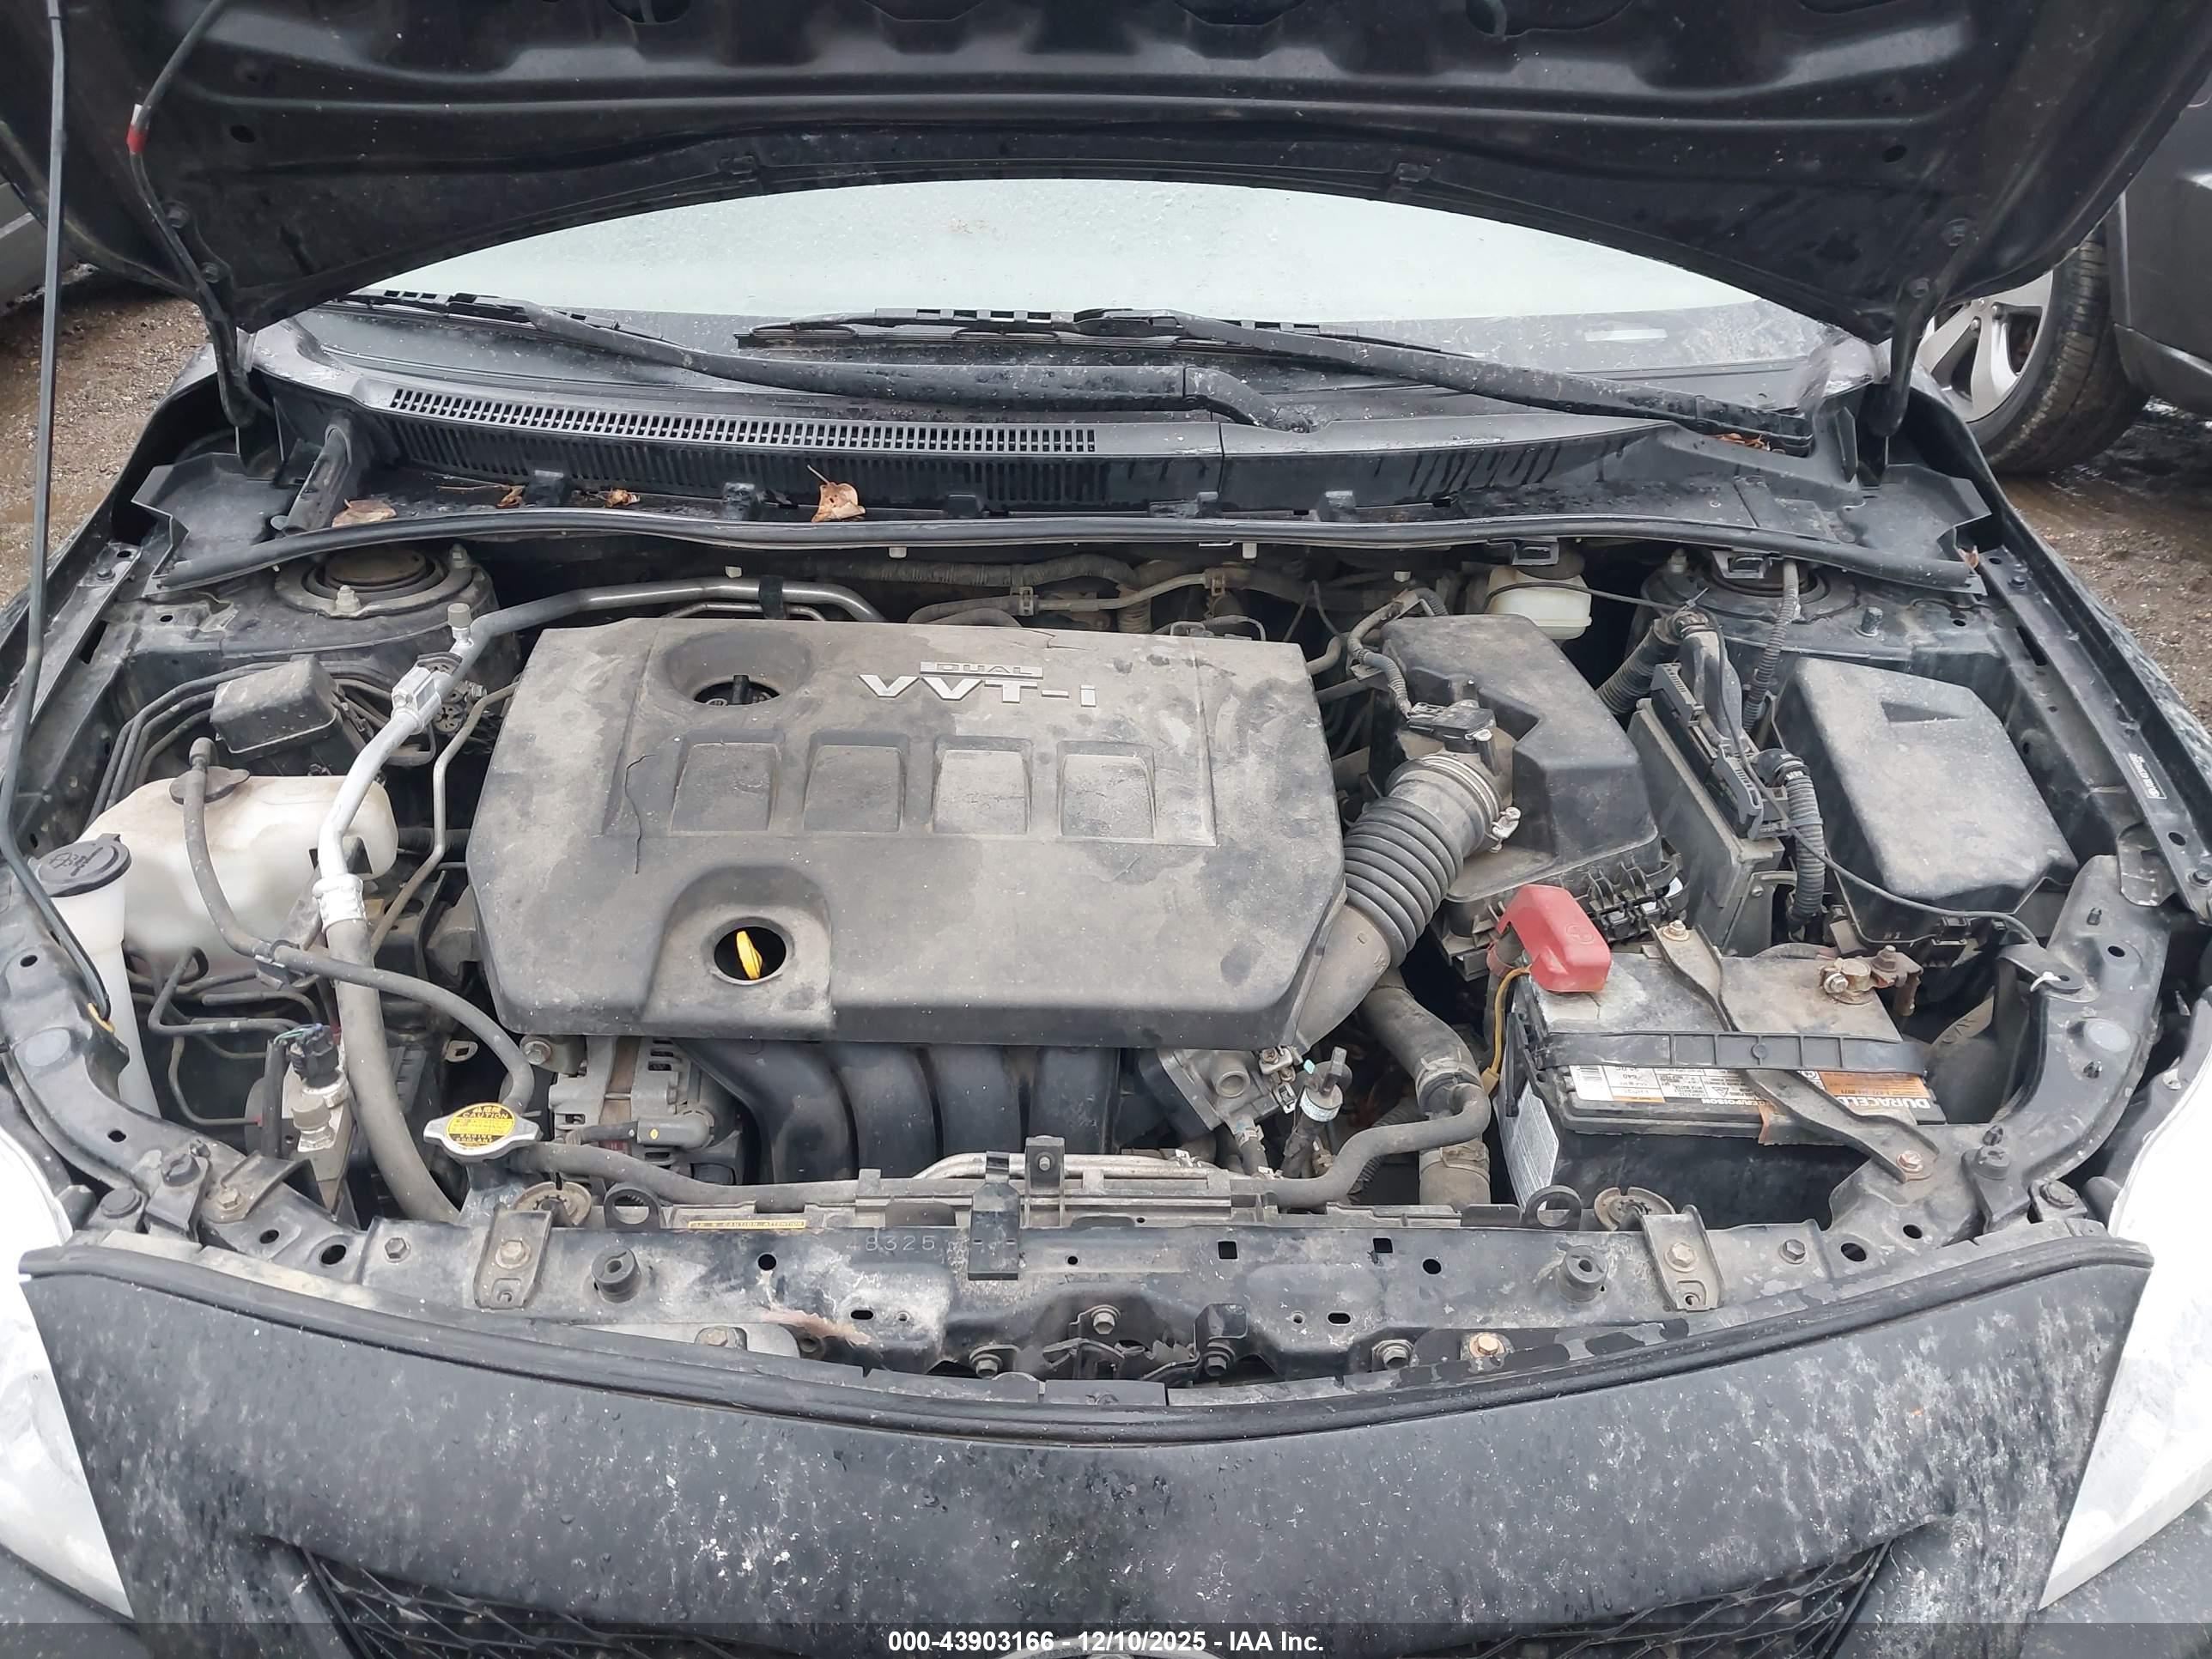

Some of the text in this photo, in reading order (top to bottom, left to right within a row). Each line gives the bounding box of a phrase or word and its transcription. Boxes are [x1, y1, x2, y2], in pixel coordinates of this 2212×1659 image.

[935, 662, 1035, 676] DUAL
[859, 673, 1097, 707] VVT-i
[865, 1235, 936, 1251] 8325
